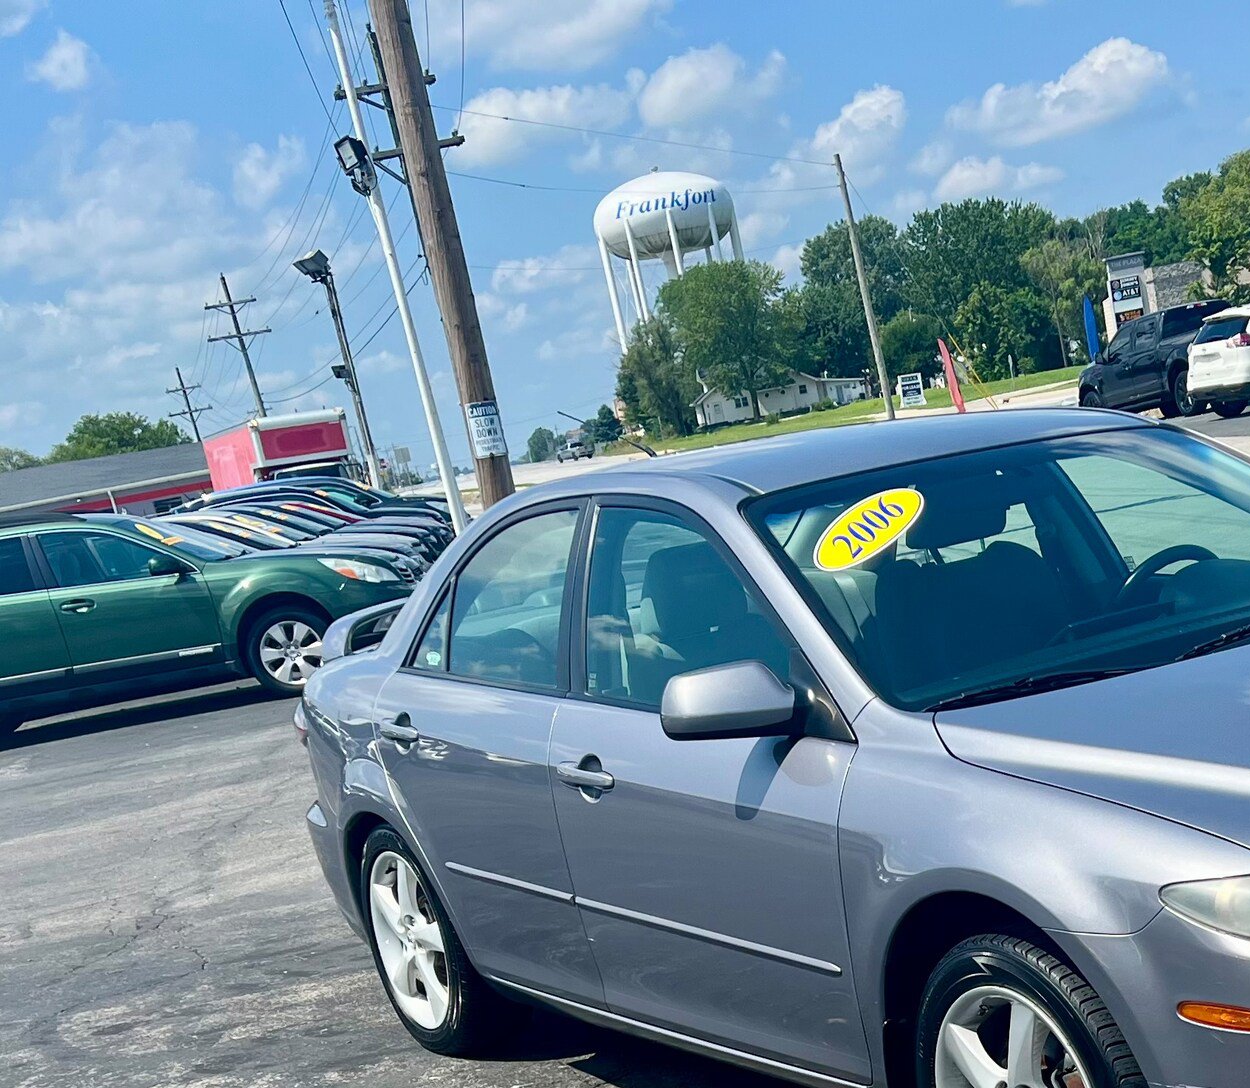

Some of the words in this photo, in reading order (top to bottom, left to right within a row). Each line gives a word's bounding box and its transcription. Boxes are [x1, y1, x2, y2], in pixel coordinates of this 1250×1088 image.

[615, 188, 716, 220] Frankfort
[1122, 287, 1139, 297] AT&T
[468, 405, 497, 417] CAUTION
[474, 417, 495, 428] SLOW
[476, 427, 498, 439] DOWN
[832, 497, 904, 559] 2006
